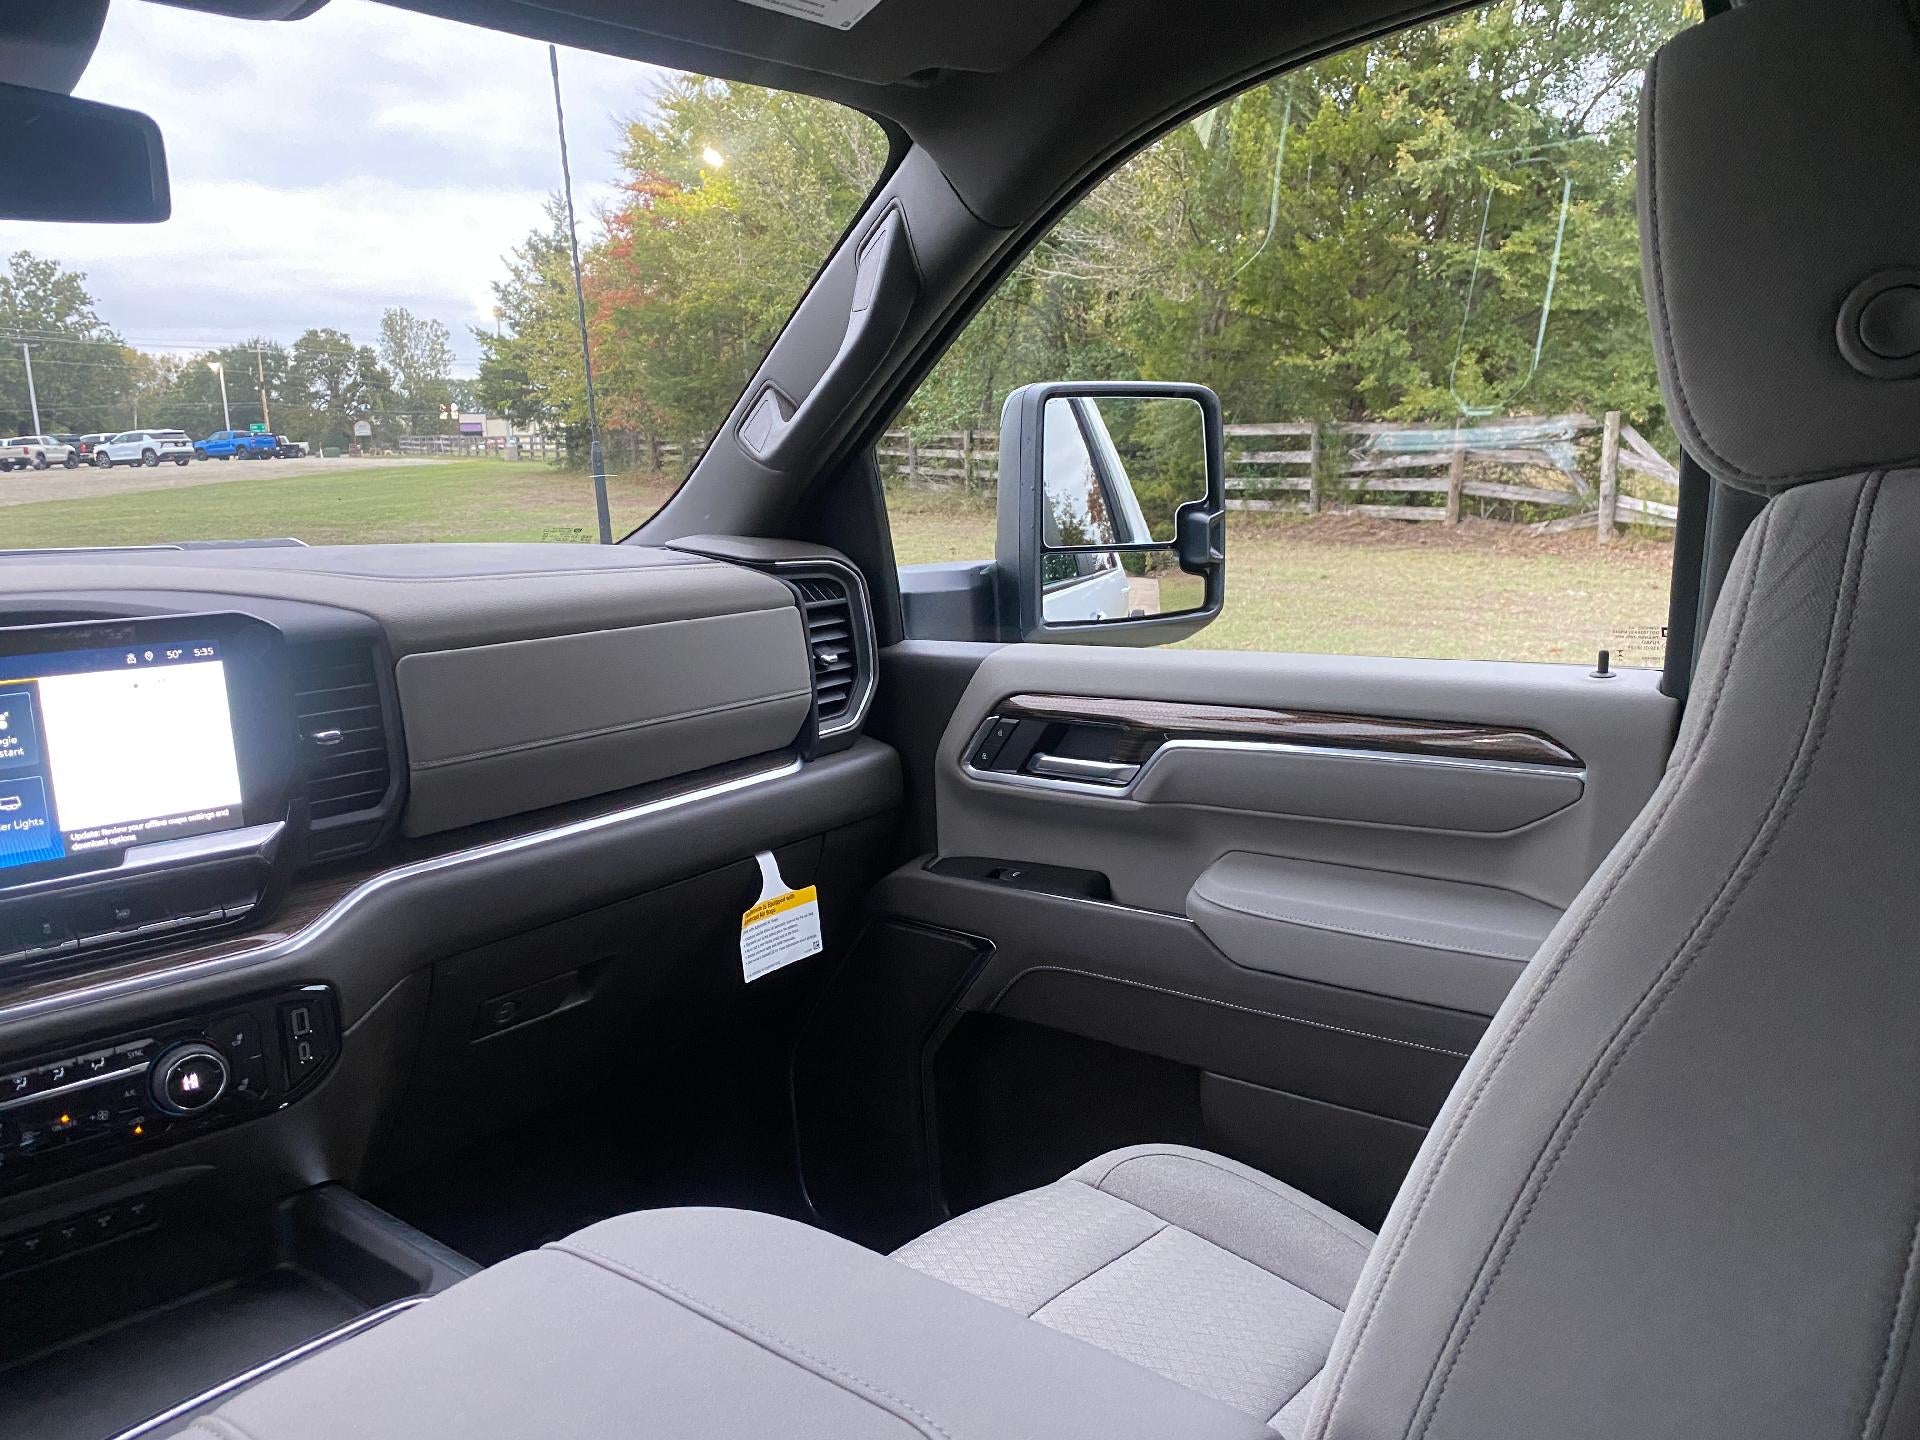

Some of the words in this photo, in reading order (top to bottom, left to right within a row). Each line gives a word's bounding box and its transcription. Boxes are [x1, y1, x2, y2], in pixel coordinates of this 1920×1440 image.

[193, 647, 214, 657] 5:35
[14, 817, 44, 831] Lights
[70, 830, 100, 841] Update:
[101, 826, 127, 837] Review
[127, 822, 144, 833] your
[215, 809, 229, 817] and
[71, 837, 108, 850] download
[109, 834, 137, 845] options
[127, 1049, 144, 1059] SYNC
